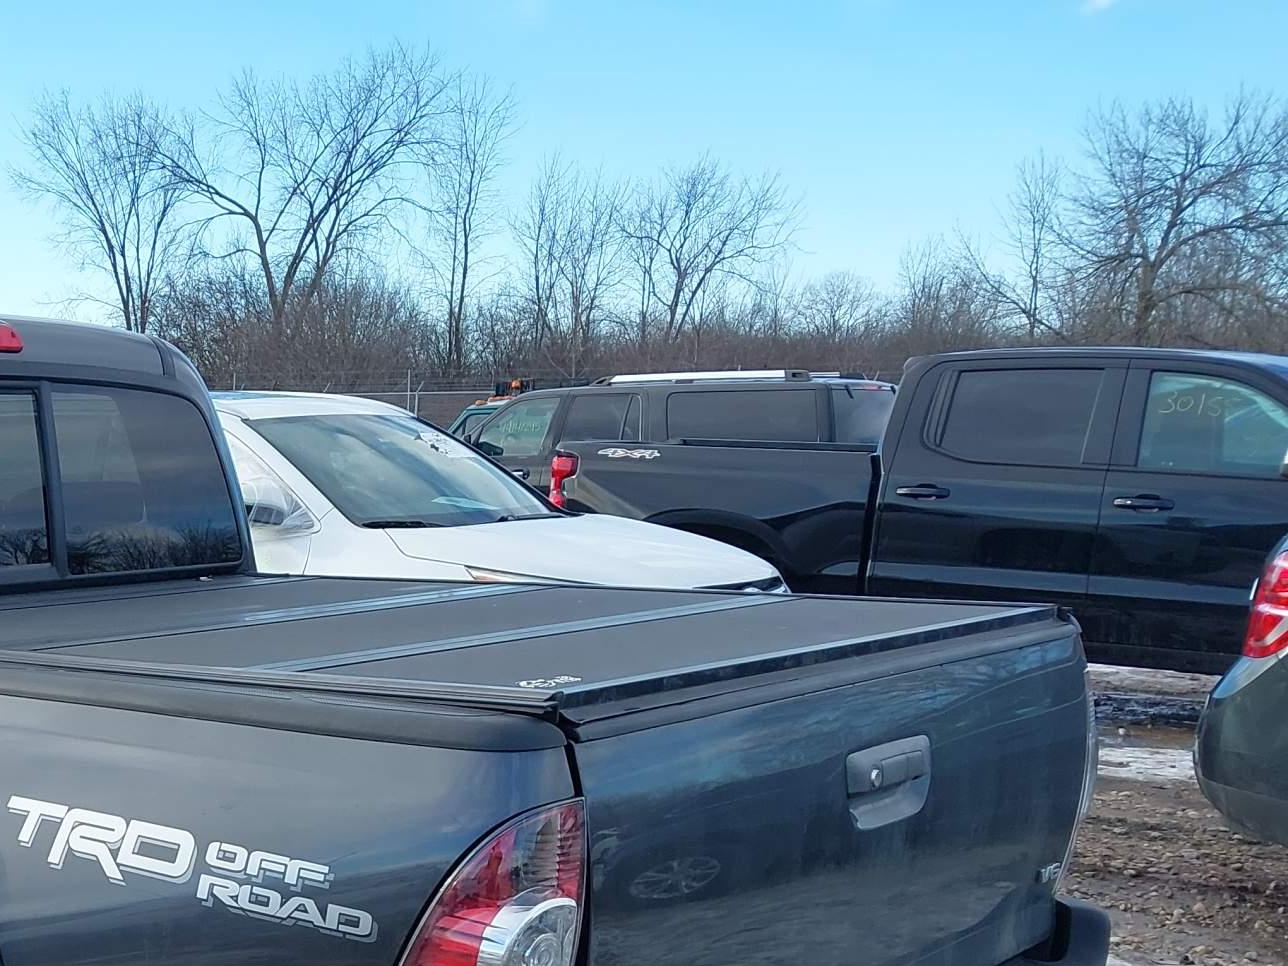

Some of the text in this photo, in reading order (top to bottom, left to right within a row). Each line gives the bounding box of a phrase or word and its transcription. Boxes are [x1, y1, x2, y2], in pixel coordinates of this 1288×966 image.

[7, 795, 198, 887] TRD
[205, 841, 336, 892] OFF
[196, 874, 379, 943] ROAD
